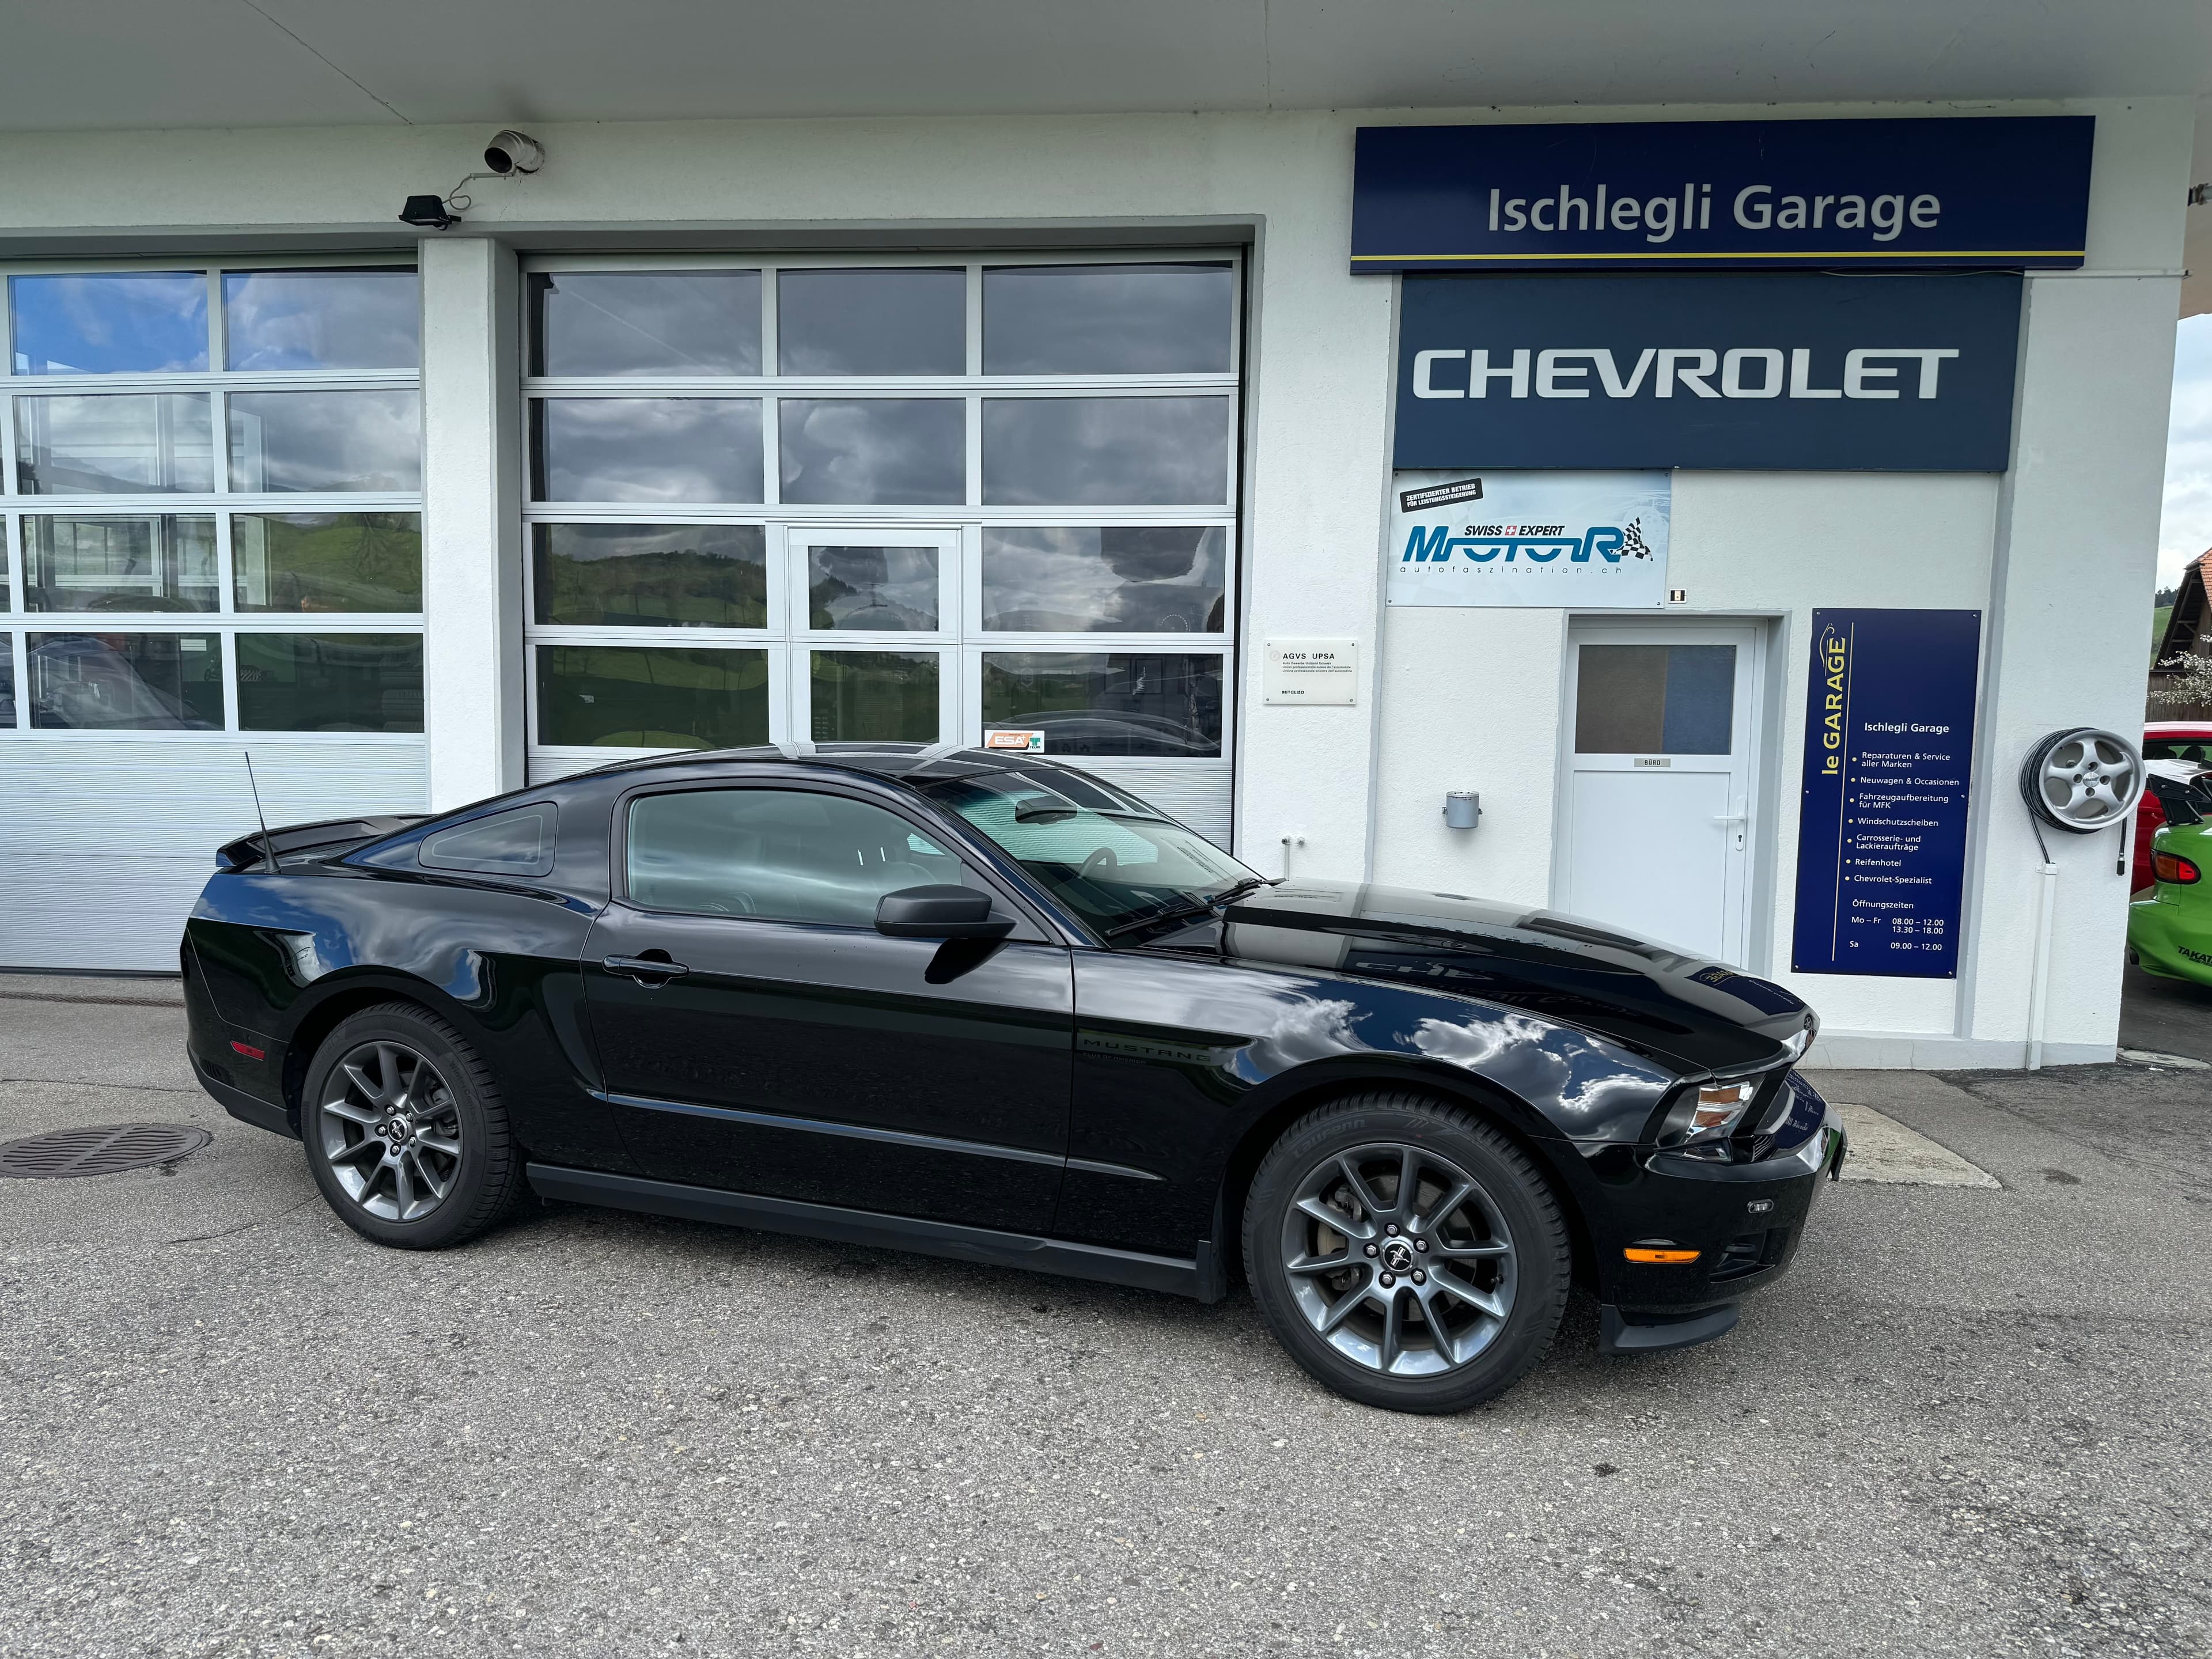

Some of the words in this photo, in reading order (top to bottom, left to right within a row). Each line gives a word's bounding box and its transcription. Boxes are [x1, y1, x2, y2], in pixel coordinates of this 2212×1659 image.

[1489, 183, 1710, 243] Ischlegli
[1733, 184, 1941, 241] Garage
[1412, 348, 1959, 399] CHEVROLET
[1406, 488, 1450, 501] ZERTIFIZIERTER
[1451, 483, 1476, 493] BETRIEB
[1418, 490, 1476, 505] LEISTUNGSSTEIGERUNG
[1464, 525, 1503, 536] SWISS
[1518, 525, 1565, 536] EXPERT
[1823, 637, 1846, 749] GARAGE
[1864, 722, 1907, 734] Ischlegli
[1911, 723, 1949, 735] Garage
[1862, 752, 1912, 760] Reparaturen
[1922, 753, 1950, 761] Service
[1821, 755, 1839, 775] le
[1860, 777, 1903, 786] Neuwagen
[1914, 778, 1959, 786] Occasionen
[1859, 793, 1949, 804] Fahrzeugaufbereitung
[1857, 817, 1938, 827] Windschutzscheiben
[1857, 834, 1903, 842] Carrosserie-
[1856, 843, 1919, 852] Lackieraufträge
[1855, 858, 1901, 867] Reifenhotel
[1854, 874, 1932, 885] Chevrolet-Spezialist
[1853, 899, 1914, 909] Öffnungszeiten
[2177, 945, 2212, 963] TAKAT
[1084, 1039, 1211, 1060] MUSTANG
